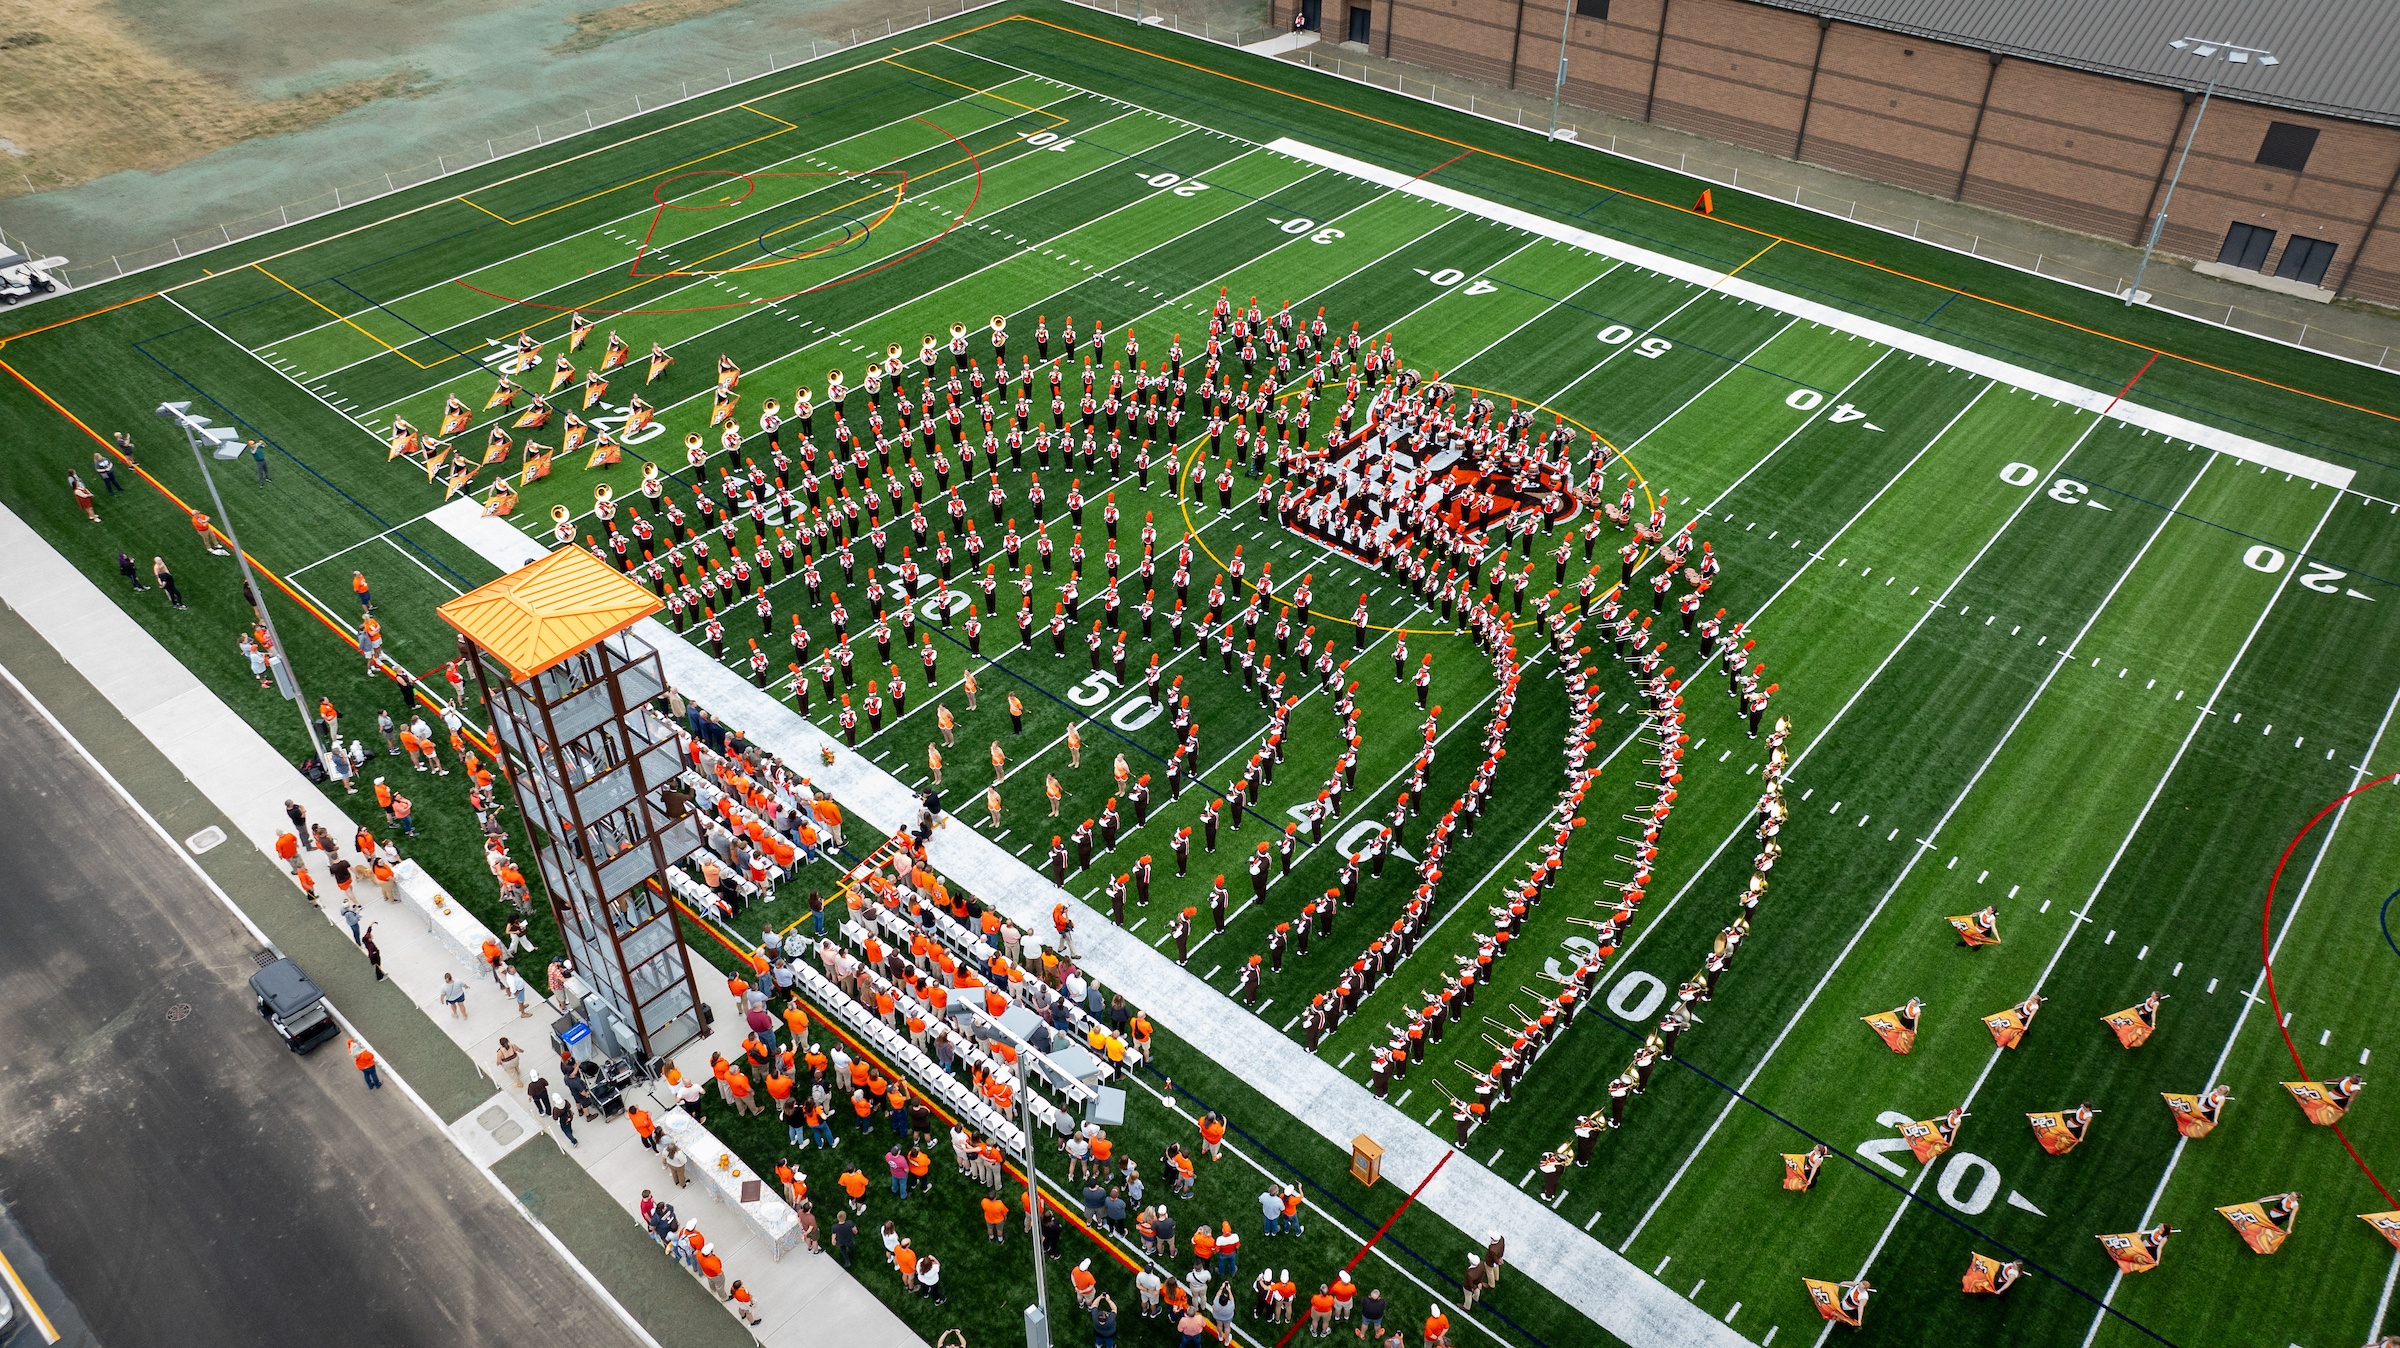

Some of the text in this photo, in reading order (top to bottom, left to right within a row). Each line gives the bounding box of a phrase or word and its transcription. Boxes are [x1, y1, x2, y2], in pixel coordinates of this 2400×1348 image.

[1027, 133, 1075, 152] 10
[1148, 173, 1210, 196] 20
[1281, 218, 1345, 245] 30
[1430, 269, 1498, 296] 40
[1597, 325, 1672, 359] 50
[1786, 389, 1866, 424] 40
[1999, 462, 2088, 504] 30
[2243, 545, 2346, 593] 20
[887, 573, 972, 621] 40
[1067, 669, 1164, 732] 50
[1286, 796, 1392, 863] 40
[1544, 936, 1668, 1022] 30
[1856, 1111, 2000, 1215] 20
